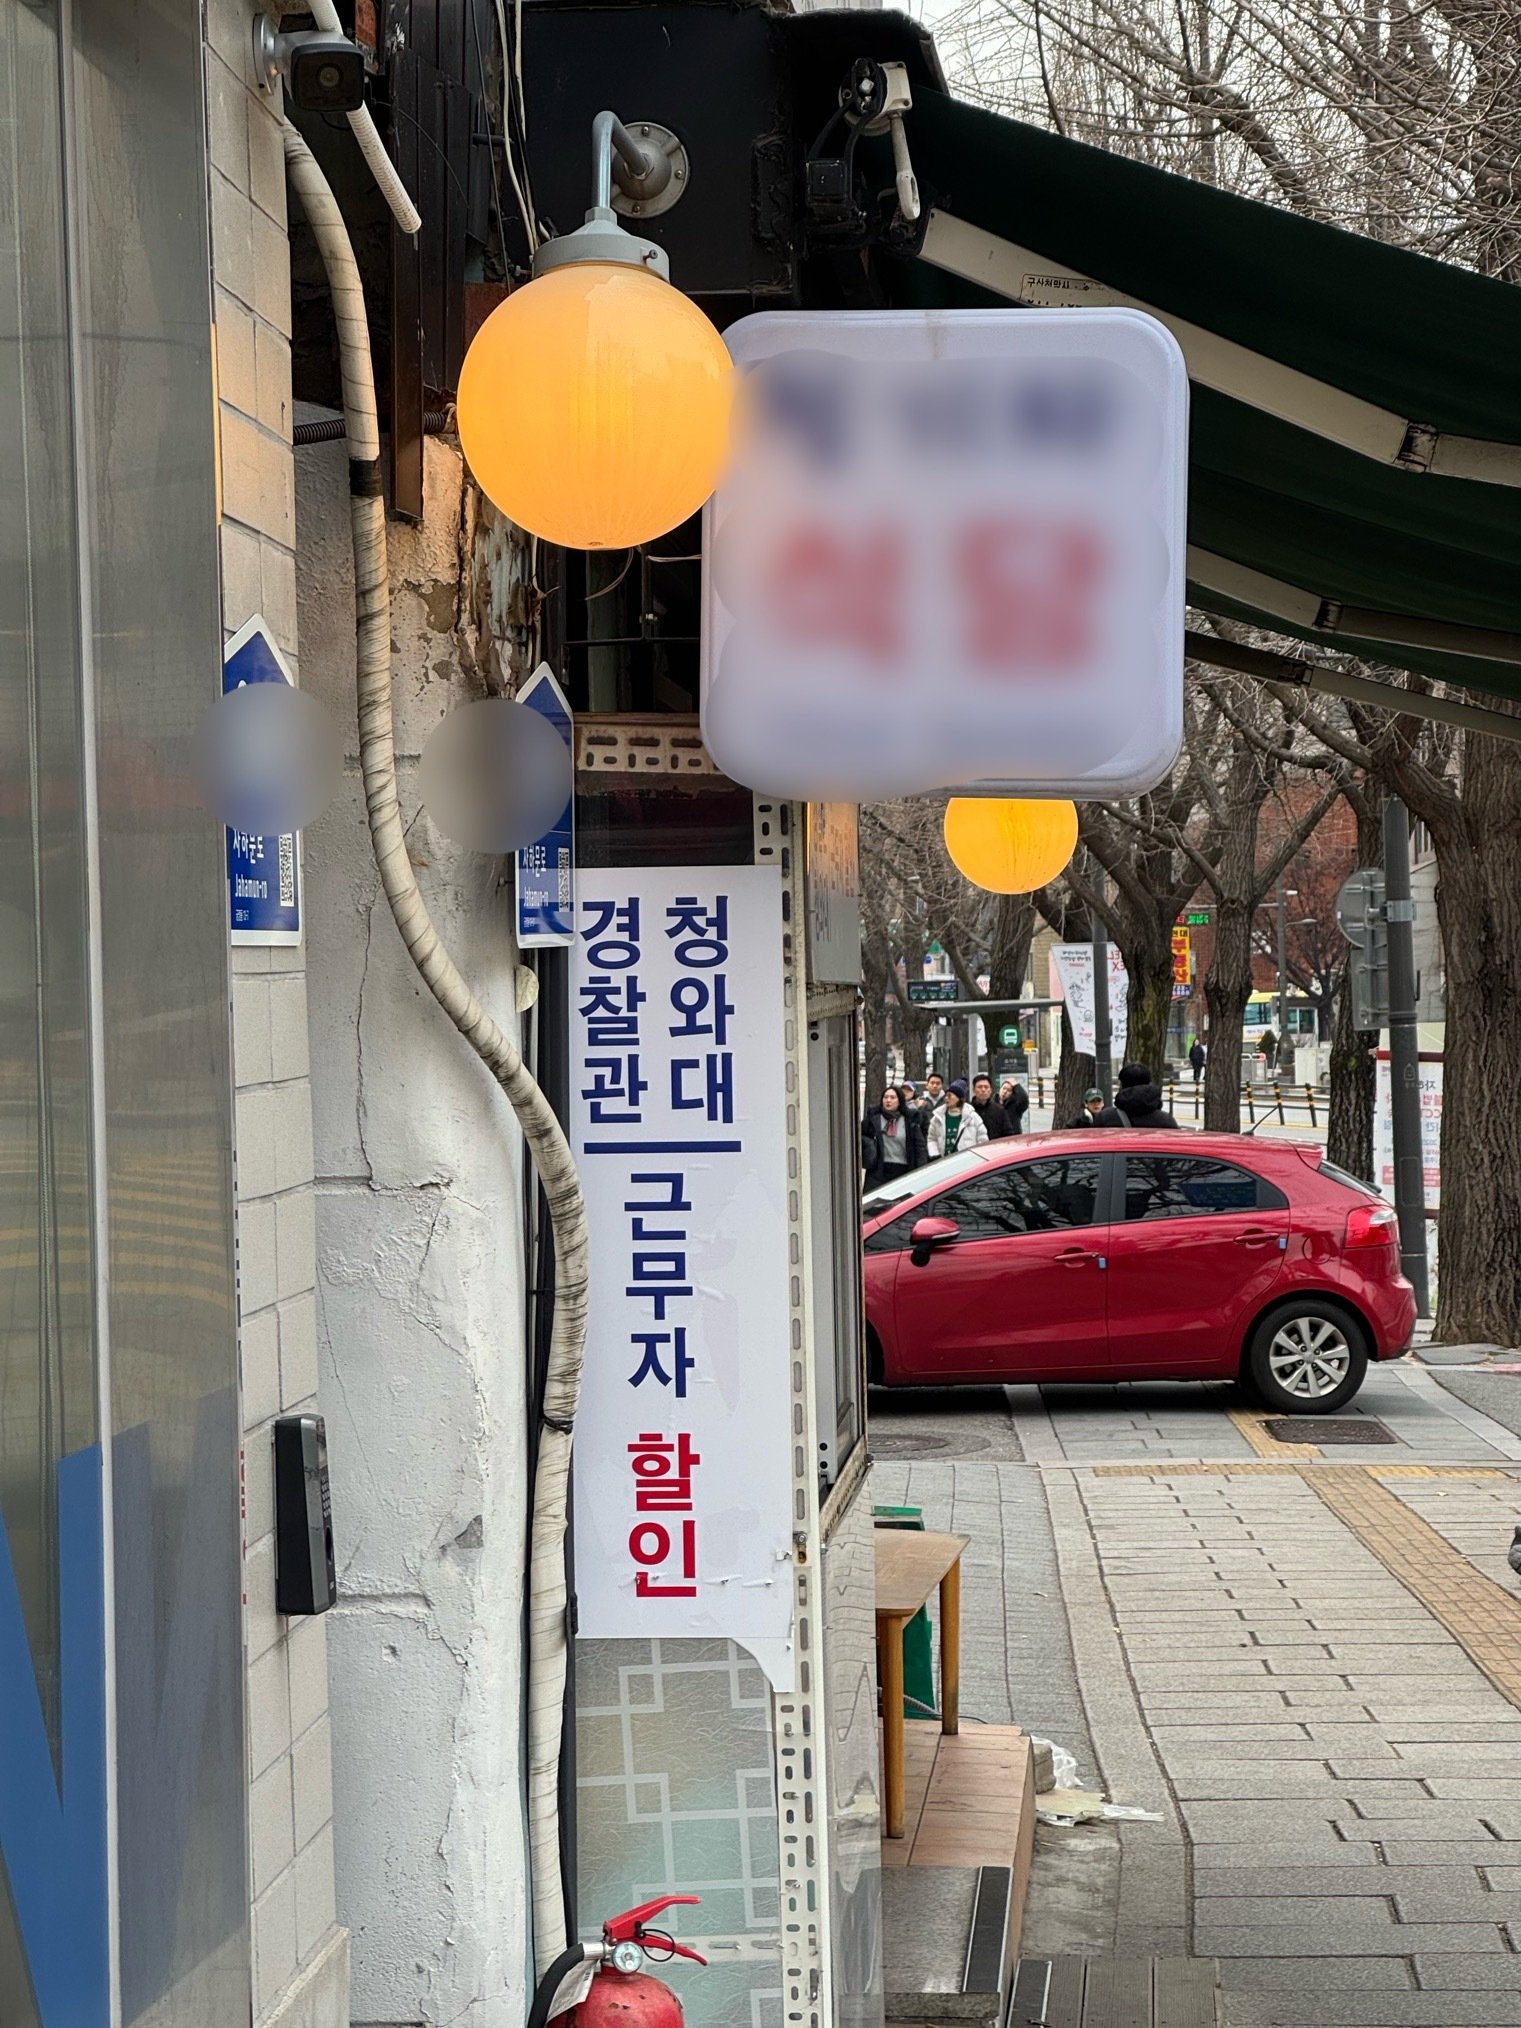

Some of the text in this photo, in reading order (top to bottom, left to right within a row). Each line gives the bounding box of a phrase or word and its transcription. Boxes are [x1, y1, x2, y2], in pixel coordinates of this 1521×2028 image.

[235, 873, 268, 899] Jahamun-ro
[578, 897, 649, 1124] 경찰관
[664, 895, 735, 1124] 청와대
[624, 1172, 701, 1598] 근무자 할인
